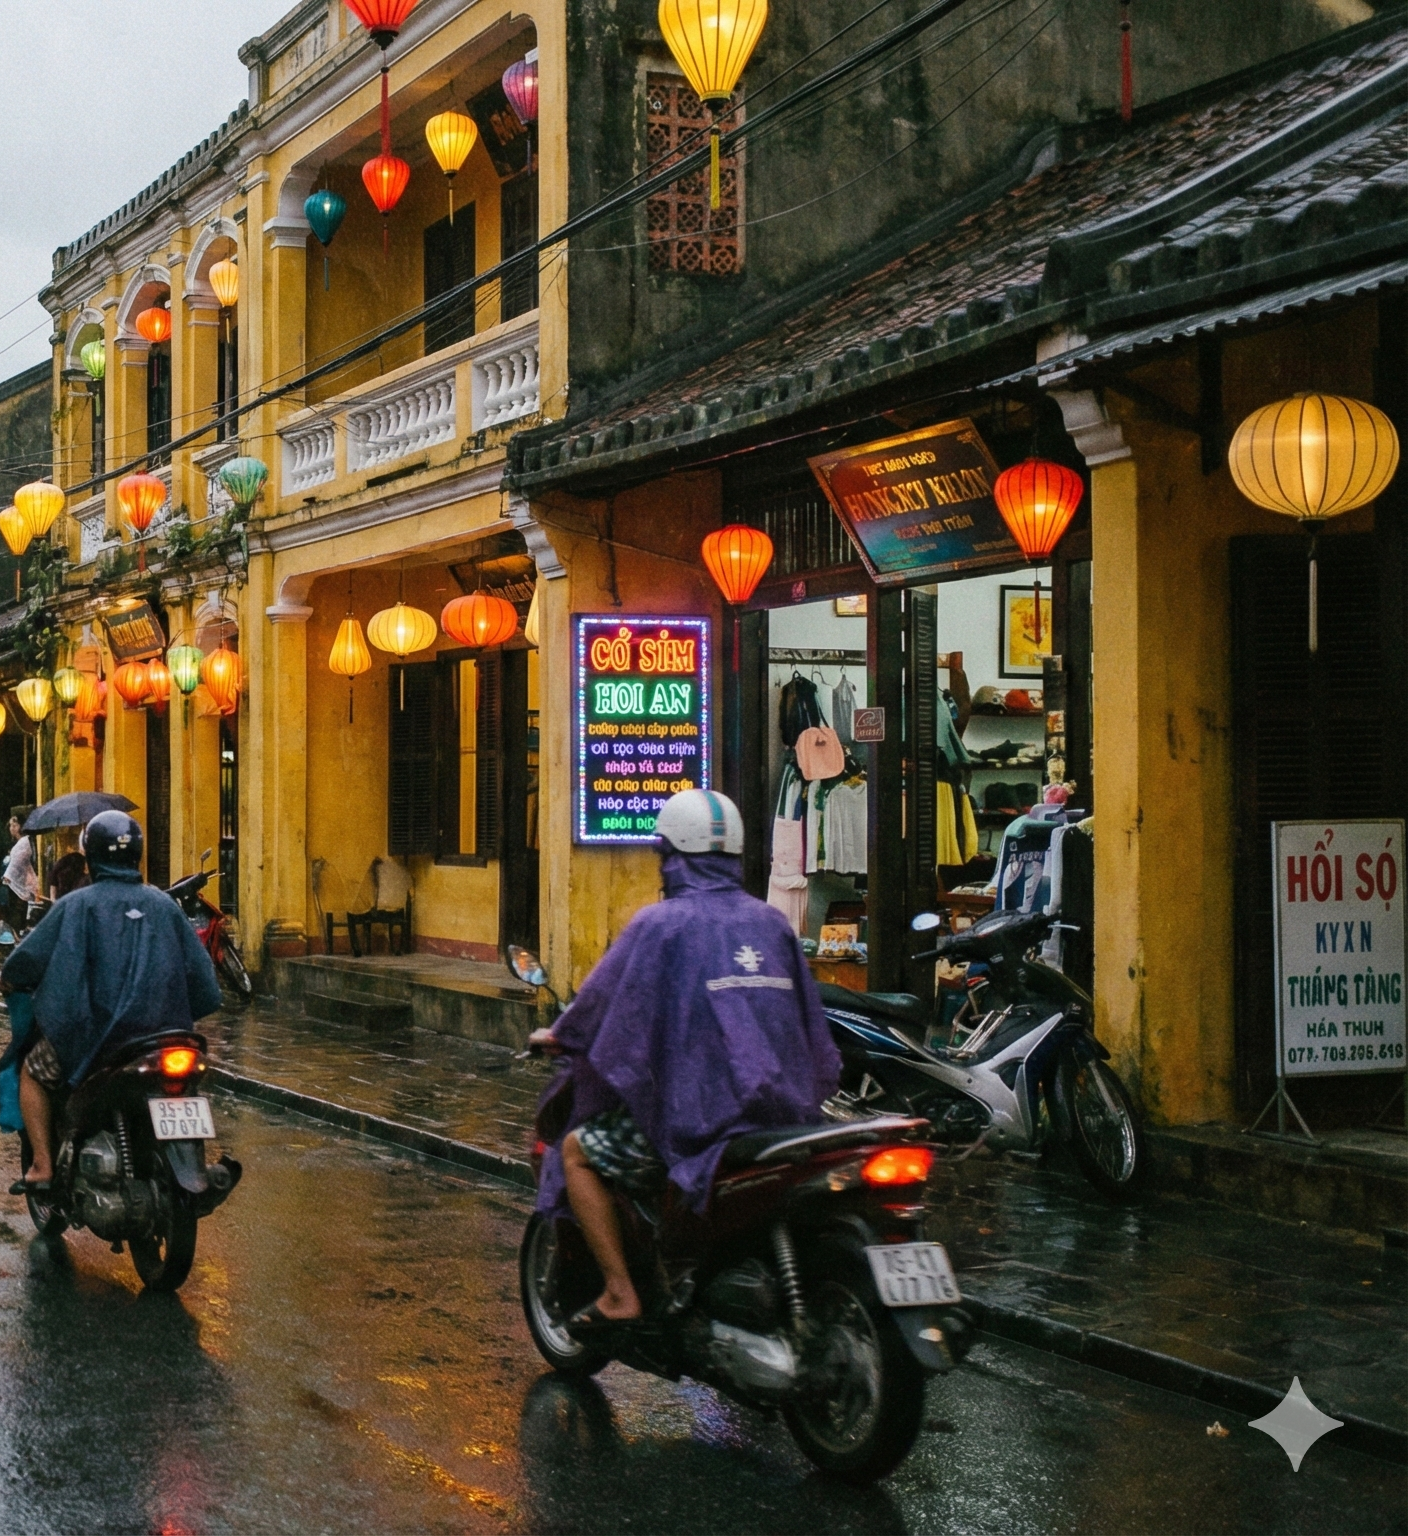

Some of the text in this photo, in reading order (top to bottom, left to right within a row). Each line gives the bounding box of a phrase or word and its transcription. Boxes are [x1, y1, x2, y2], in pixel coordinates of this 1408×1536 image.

[595, 682, 691, 714] HOI AN
[1287, 828, 1343, 903] HỔI
